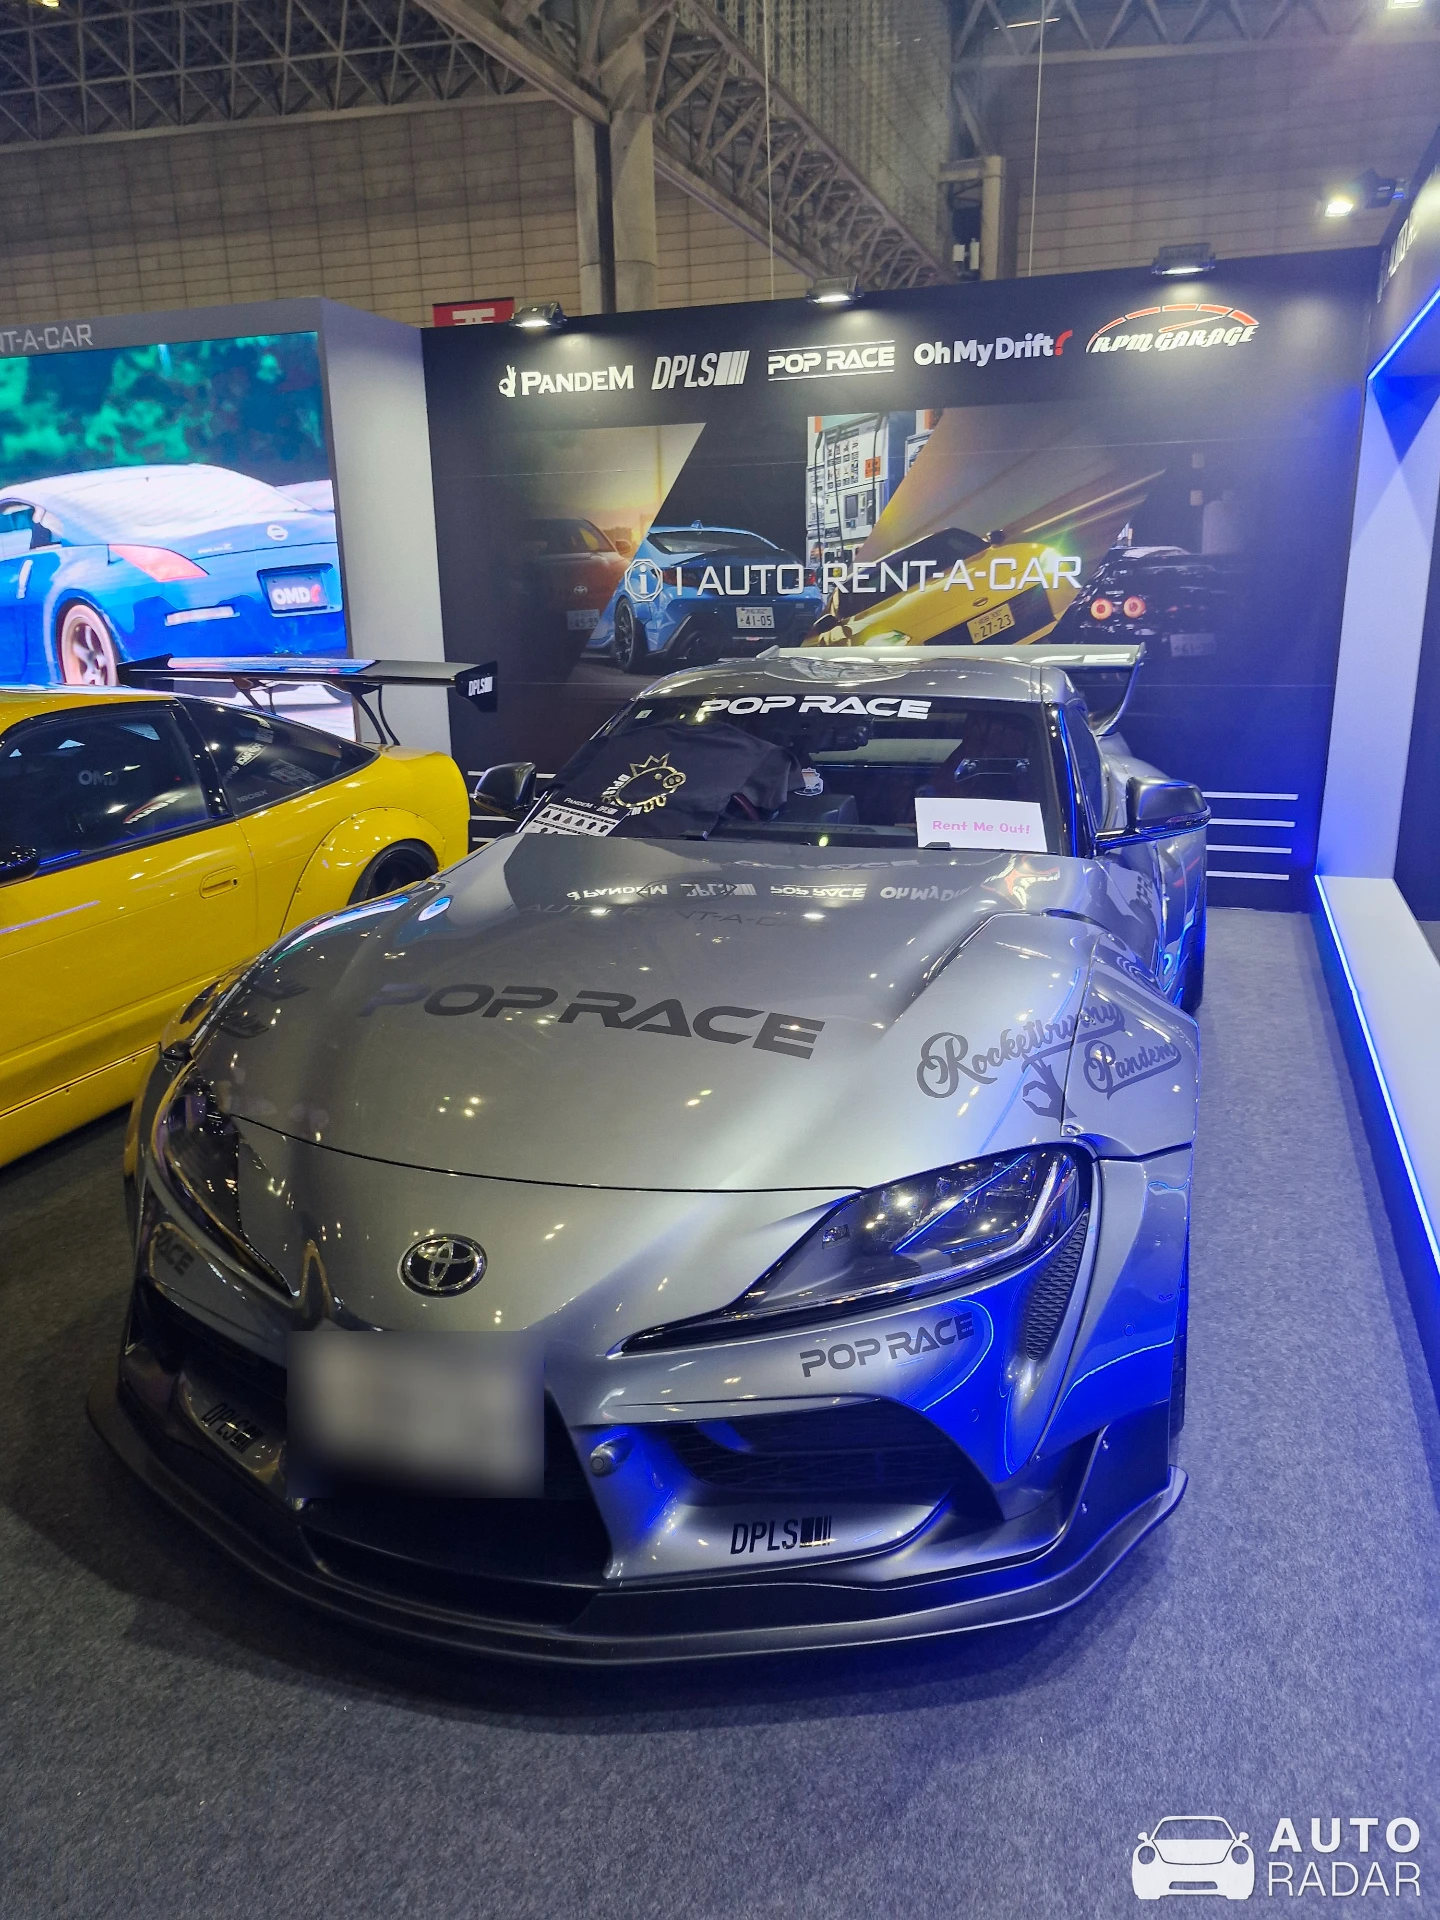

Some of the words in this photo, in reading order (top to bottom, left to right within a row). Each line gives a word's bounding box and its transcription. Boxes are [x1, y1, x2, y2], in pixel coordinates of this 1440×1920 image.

[0, 324, 93, 353] T-A-CAR
[914, 341, 950, 366] Oh
[954, 339, 994, 367] My
[1090, 333, 1153, 354] RPM
[1154, 325, 1260, 352] GARAGE
[768, 353, 822, 375] POP
[826, 346, 895, 371] RACE
[697, 564, 805, 596] AUTO
[822, 556, 1082, 594] RENT-A-CAR
[745, 615, 772, 627] 41-05
[695, 696, 796, 717] POP
[798, 696, 932, 720] RACE
[932, 821, 968, 830] Rent
[974, 822, 994, 831] Me
[1000, 823, 1030, 834] Out!
[359, 983, 559, 1018] POP
[557, 990, 825, 1059] RACE
[1084, 1040, 1181, 1100] Pandem
[799, 1338, 881, 1378] POP
[885, 1311, 975, 1360] RACE
[730, 1518, 799, 1555] DPLS
